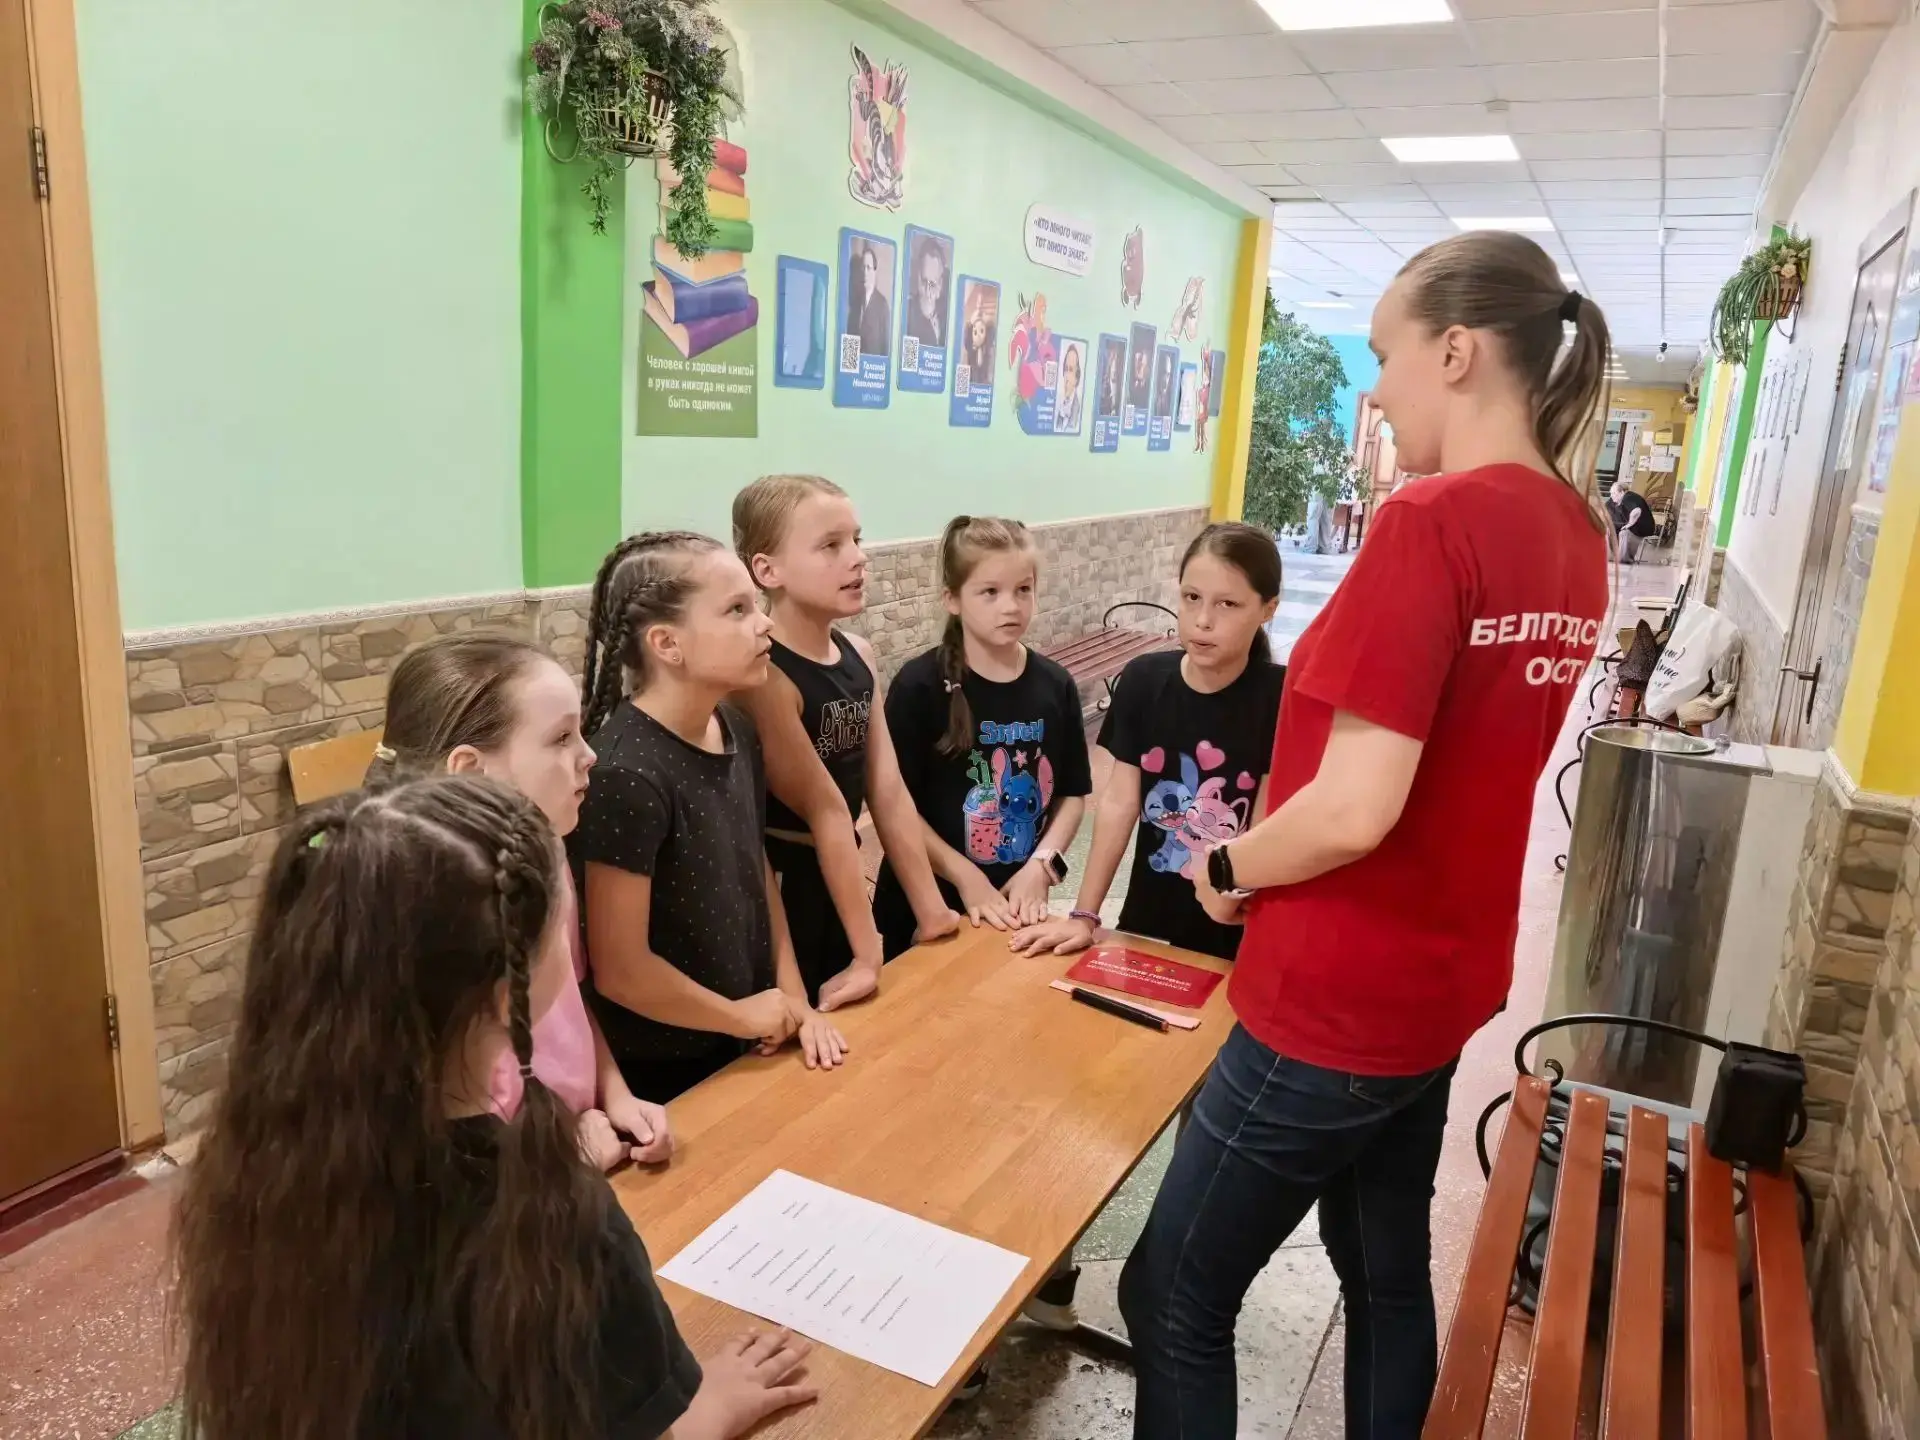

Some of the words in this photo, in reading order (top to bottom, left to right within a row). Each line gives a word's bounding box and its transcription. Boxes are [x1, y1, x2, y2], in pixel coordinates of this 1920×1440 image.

[646, 354, 683, 371] Человек
[685, 361, 690, 371] с
[692, 361, 727, 376] хорошей
[728, 364, 755, 377] книгой
[648, 377, 654, 388] в
[655, 378, 680, 391] руках
[681, 380, 714, 394] никогда
[715, 382, 725, 393] не
[726, 384, 753, 395] может
[668, 395, 690, 409] быть
[692, 399, 733, 412] одиноким.
